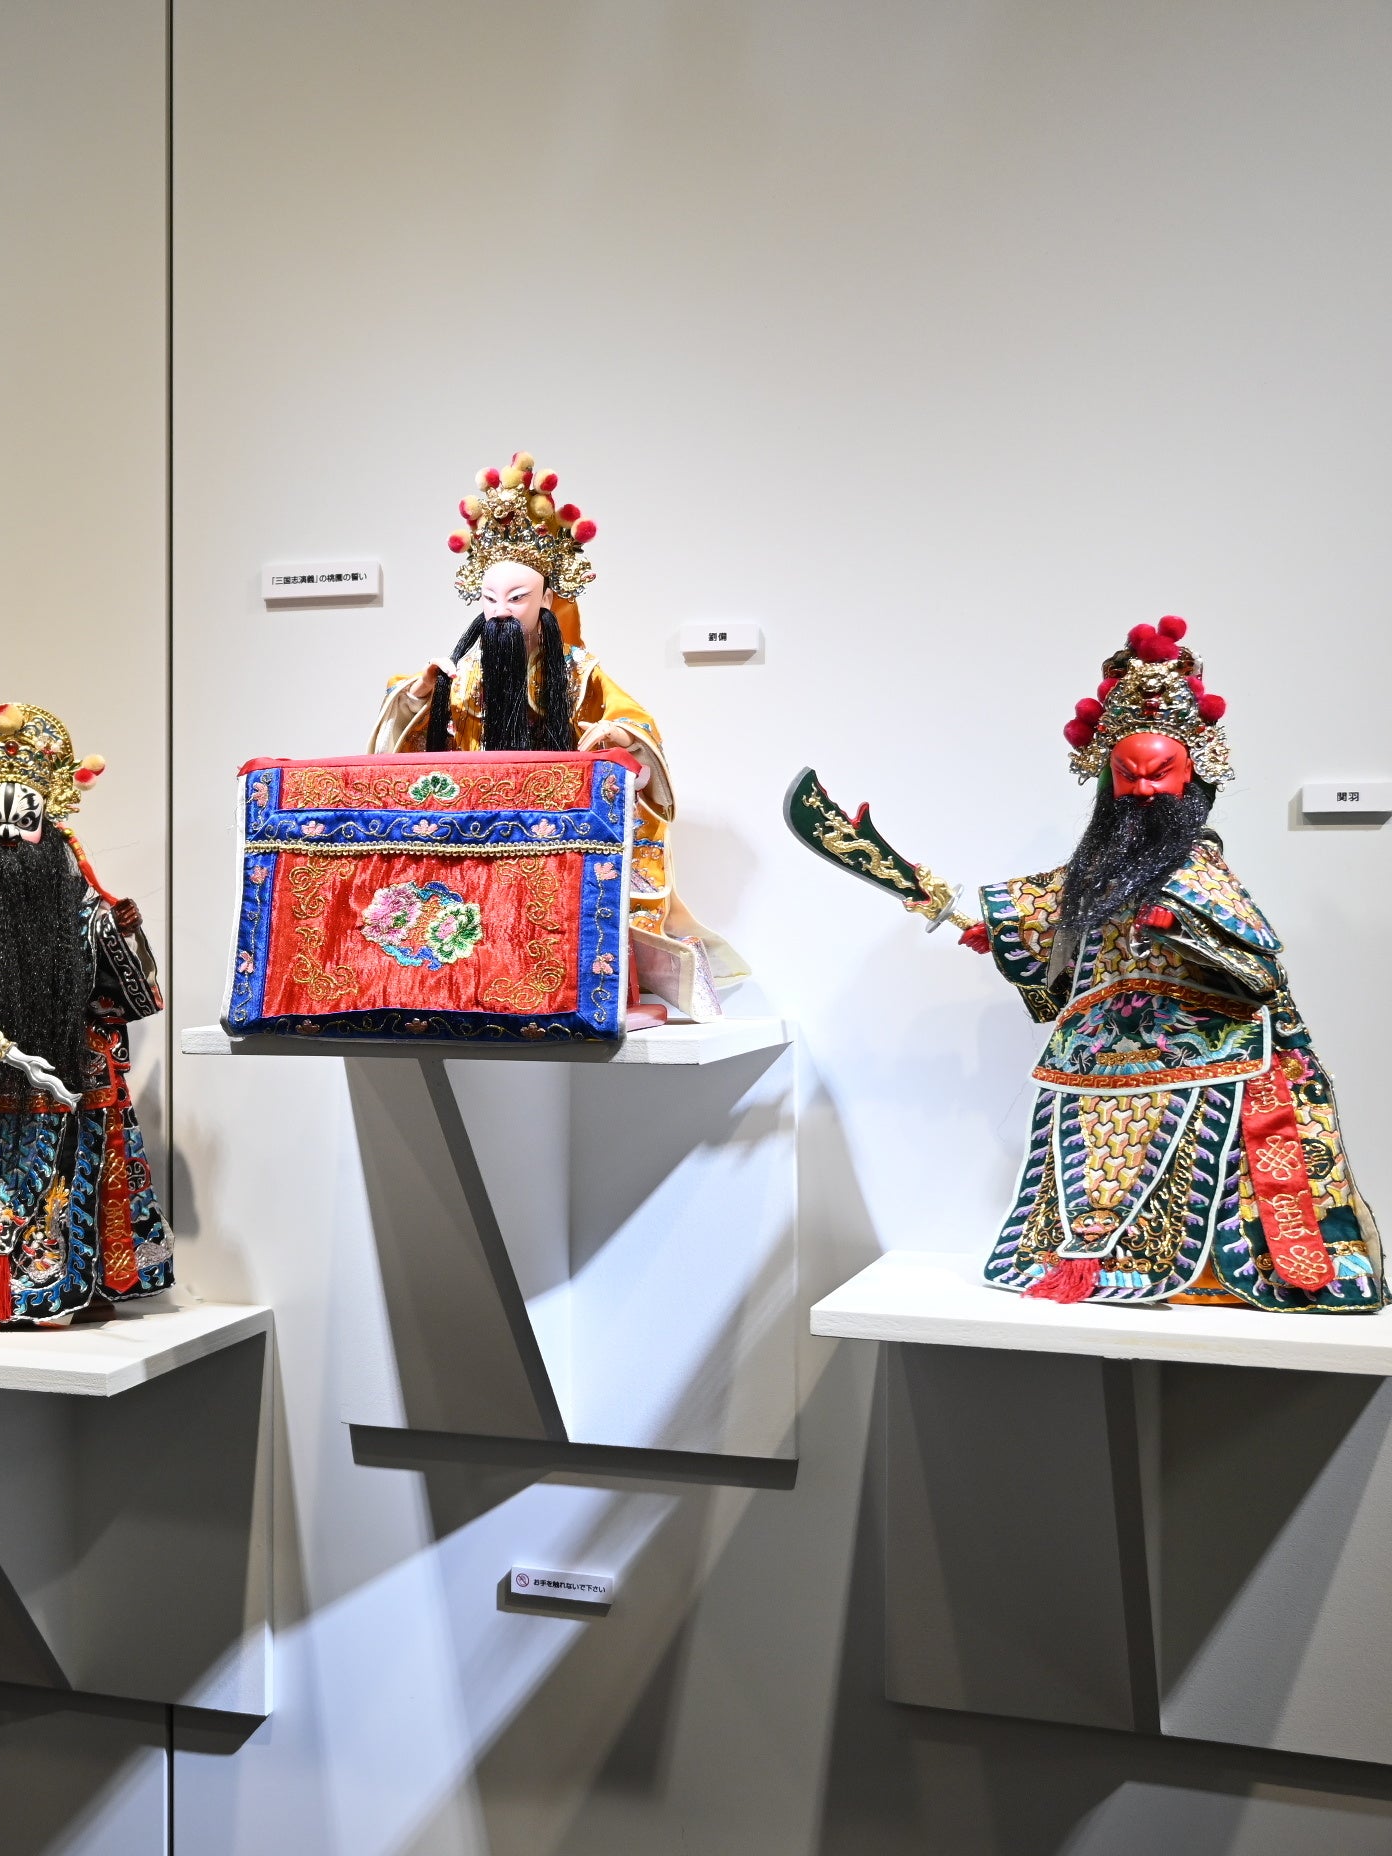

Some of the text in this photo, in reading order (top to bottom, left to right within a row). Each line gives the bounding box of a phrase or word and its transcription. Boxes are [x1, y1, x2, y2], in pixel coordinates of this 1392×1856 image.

[708, 632, 728, 642] 劉備
[1336, 791, 1360, 802] 関羽
[533, 1578, 606, 1593] お手を触れないで下さい
